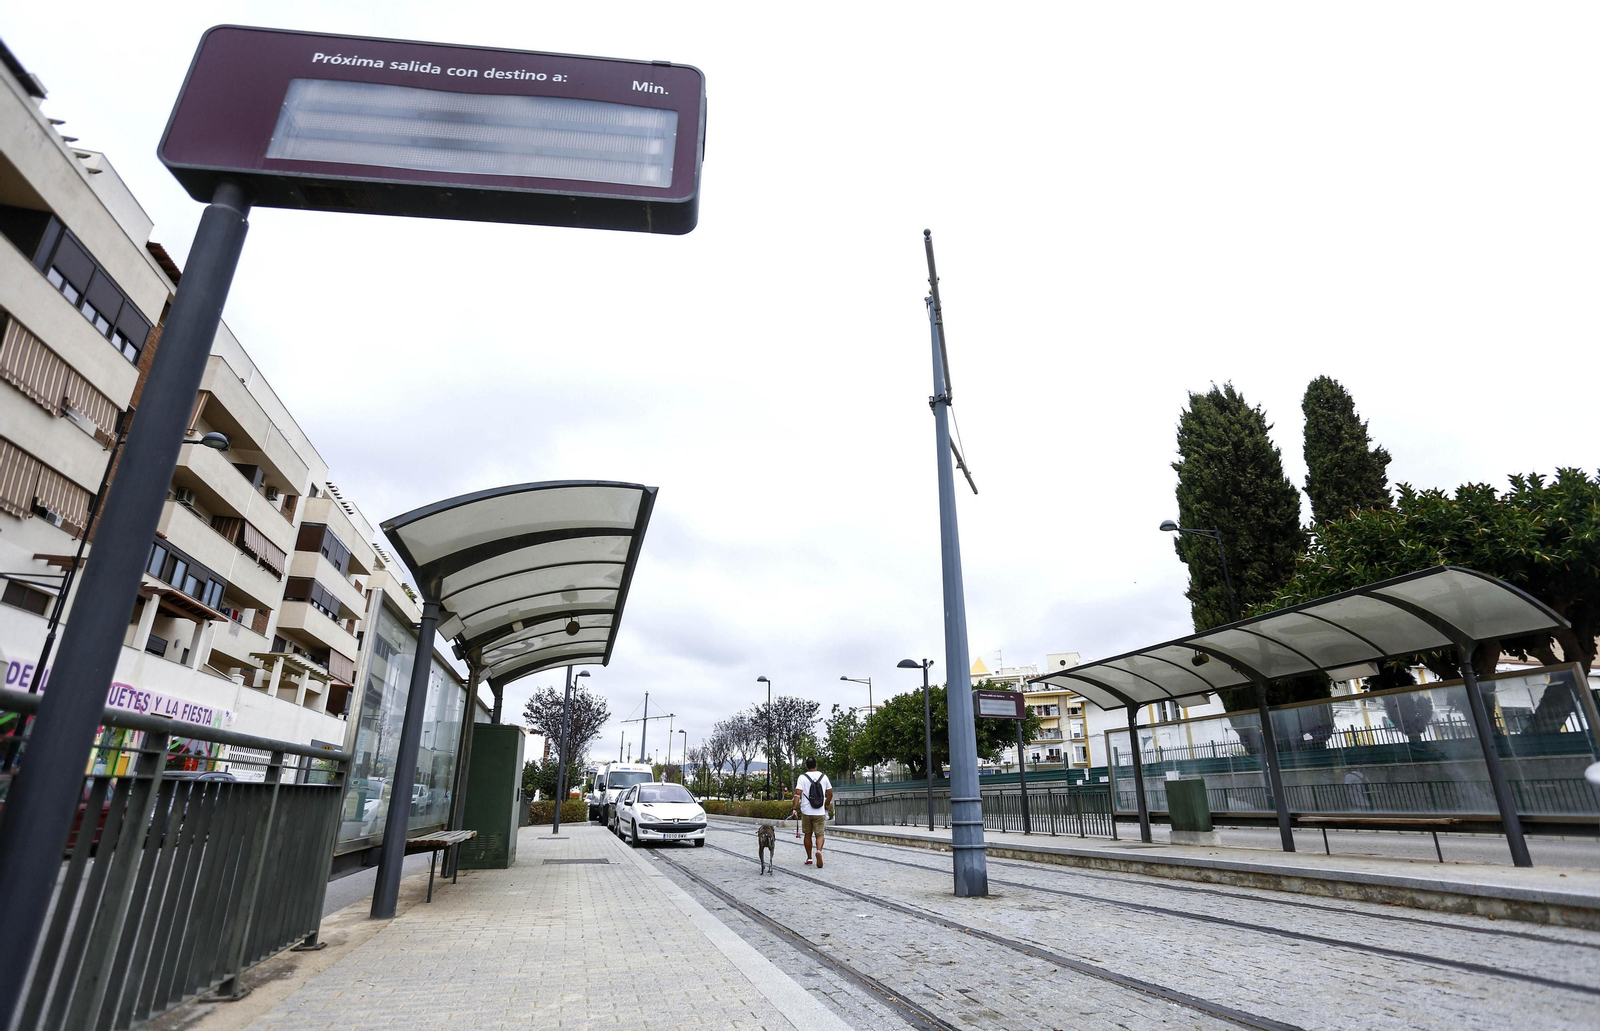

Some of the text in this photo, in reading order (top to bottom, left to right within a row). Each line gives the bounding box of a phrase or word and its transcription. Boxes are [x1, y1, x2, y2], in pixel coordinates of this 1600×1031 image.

[311, 52, 568, 83] Próxima salida con destino a:
[632, 80, 669, 95] Min.
[6, 661, 34, 688] DE
[108, 685, 151, 712] UETES
[154, 696, 163, 712] Y
[165, 699, 179, 716] LA
[180, 703, 213, 726] FIESTA
